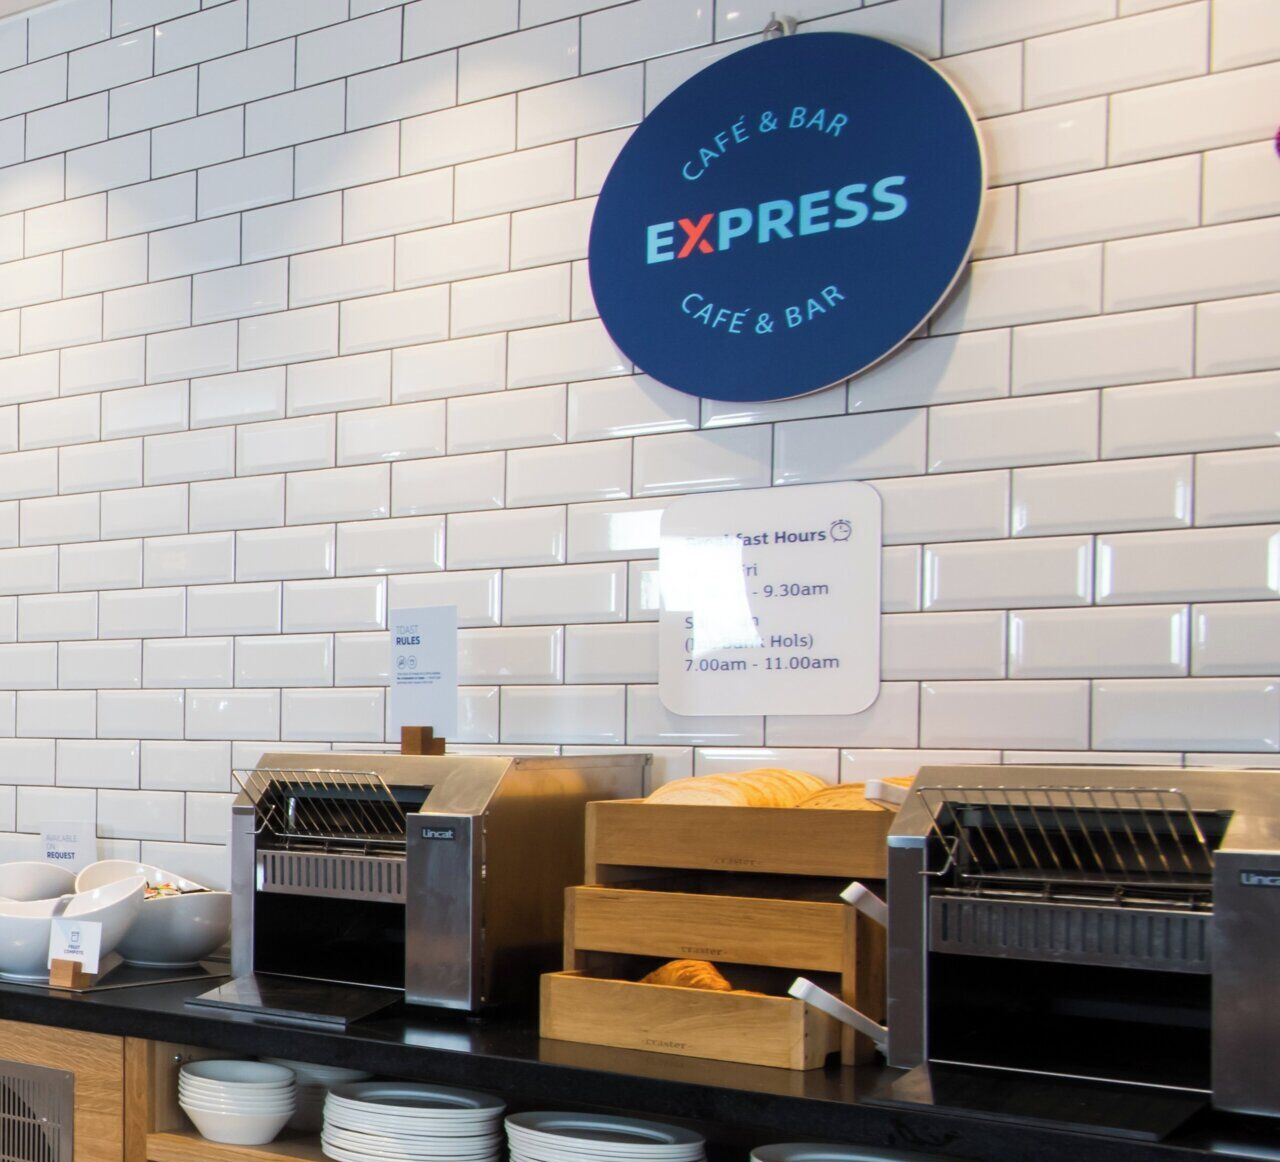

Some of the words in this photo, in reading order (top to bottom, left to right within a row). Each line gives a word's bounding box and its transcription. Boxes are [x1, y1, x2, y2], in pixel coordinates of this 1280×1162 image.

[682, 115, 749, 180] CAFÉ
[759, 111, 778, 132] &
[789, 106, 848, 137] BAR
[646, 175, 908, 264] EXPRESS
[681, 293, 750, 334] CAFÉ
[755, 313, 773, 334] &
[784, 285, 845, 328] BAR
[774, 530, 827, 544] Hours
[742, 563, 758, 576] ri
[763, 583, 829, 597] 9.30am
[396, 636, 420, 645] RULES
[770, 634, 813, 649] Hols)
[685, 659, 747, 671] 7.00am
[765, 656, 840, 670] 11.00am
[422, 828, 454, 839] Lincat
[46, 851, 75, 859] REQUEST
